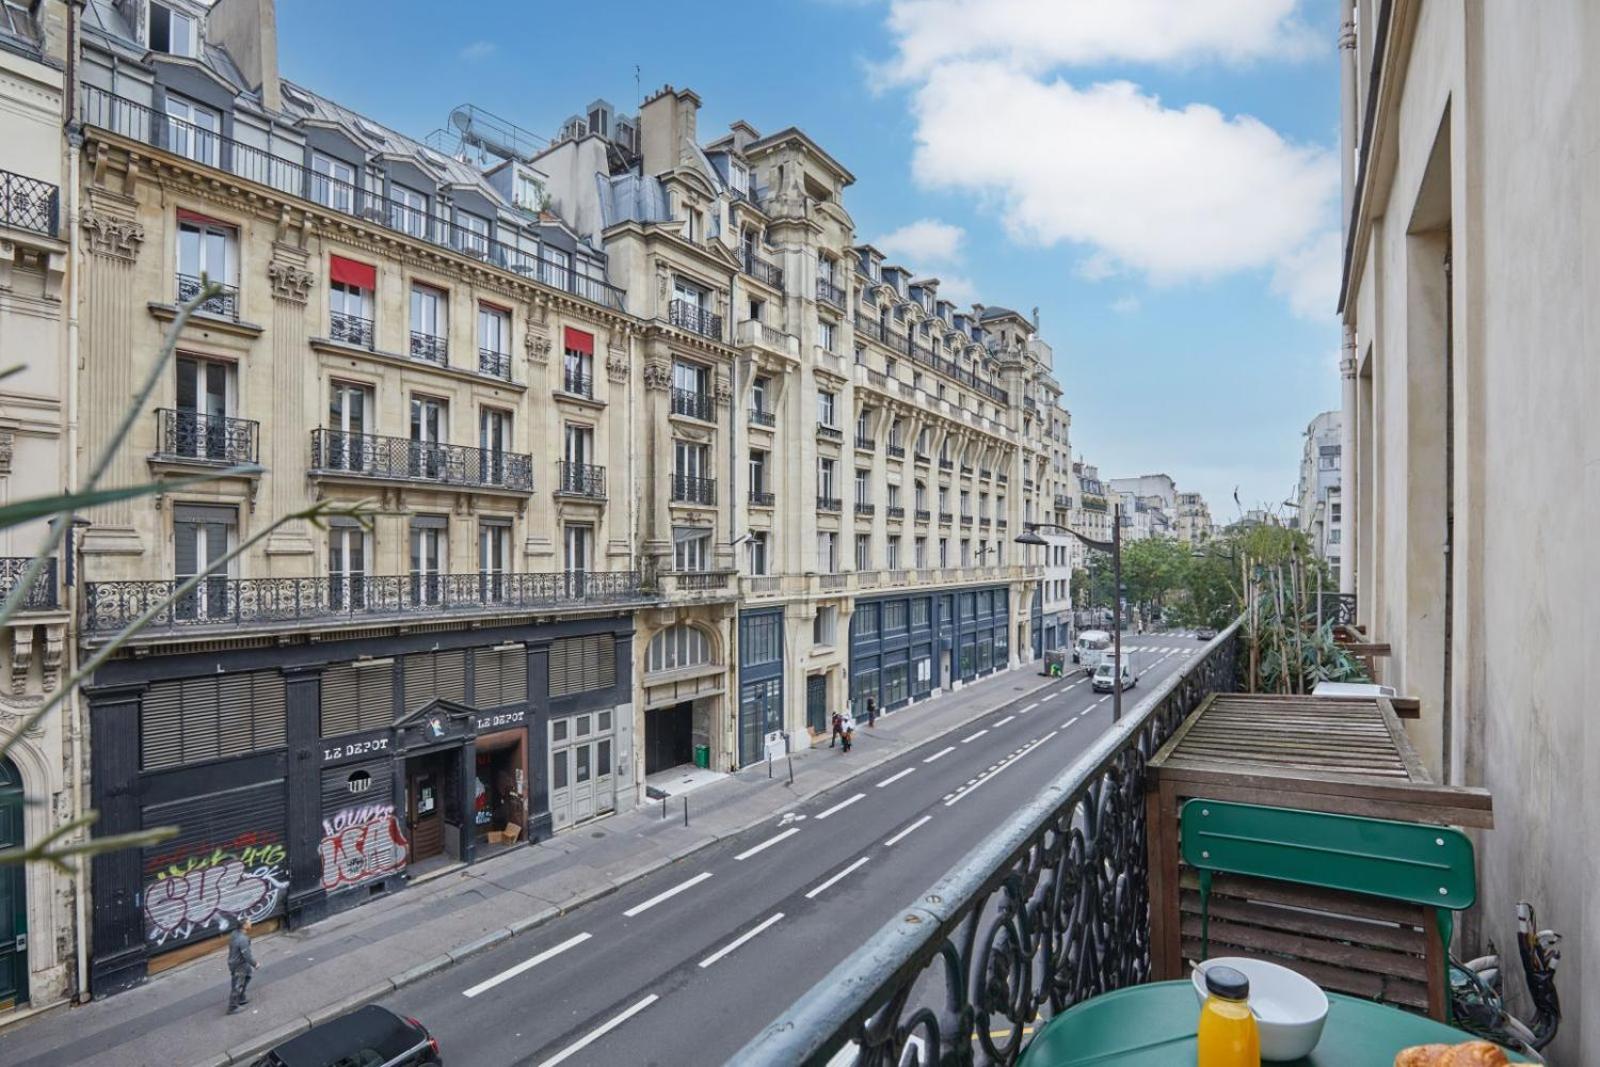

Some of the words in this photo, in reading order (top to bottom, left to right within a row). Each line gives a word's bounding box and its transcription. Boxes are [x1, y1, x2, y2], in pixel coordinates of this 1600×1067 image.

[477, 718, 490, 729] LE
[493, 711, 525, 726] DEPOT
[324, 747, 342, 760] LE
[346, 738, 389, 756] DEPOT
